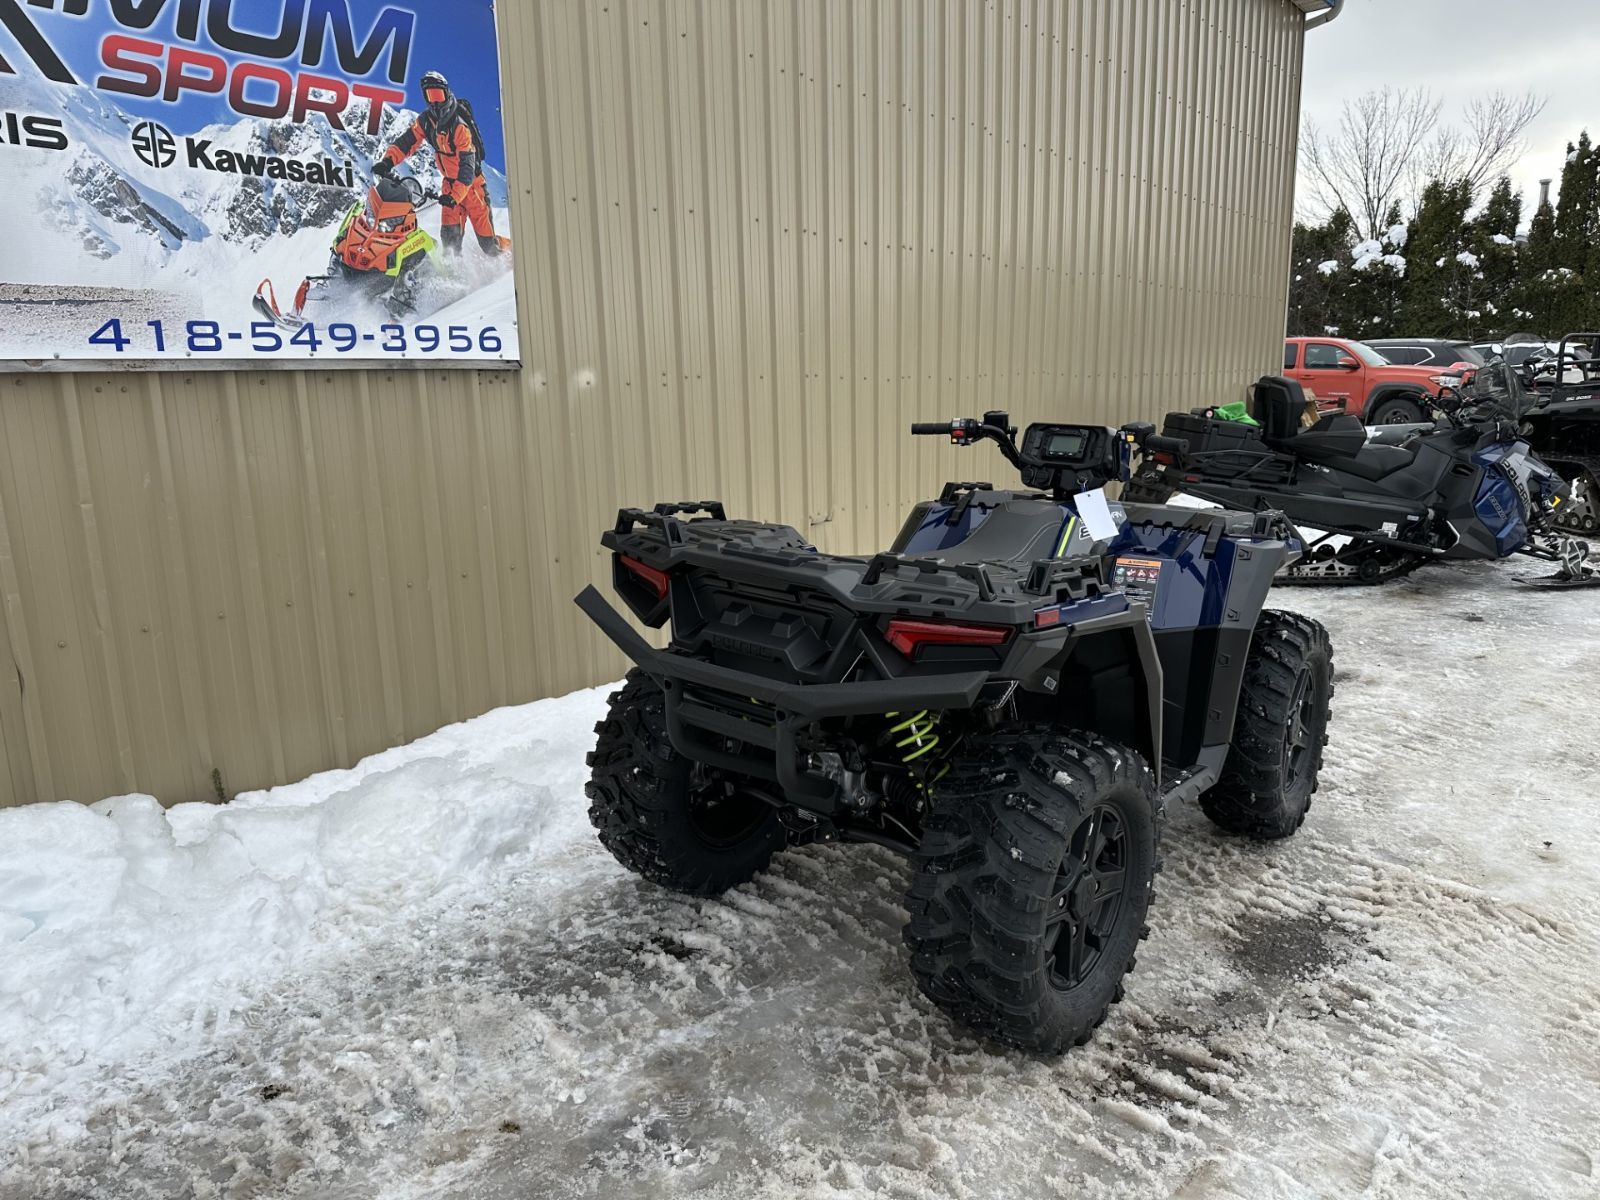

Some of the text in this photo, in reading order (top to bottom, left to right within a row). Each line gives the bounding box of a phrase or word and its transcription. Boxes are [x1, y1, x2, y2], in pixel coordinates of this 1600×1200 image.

[97, 34, 405, 136] SPORT
[0, 111, 68, 150] IS
[185, 137, 354, 188] Kawasaki
[88, 318, 502, 352] 418-549-3956
